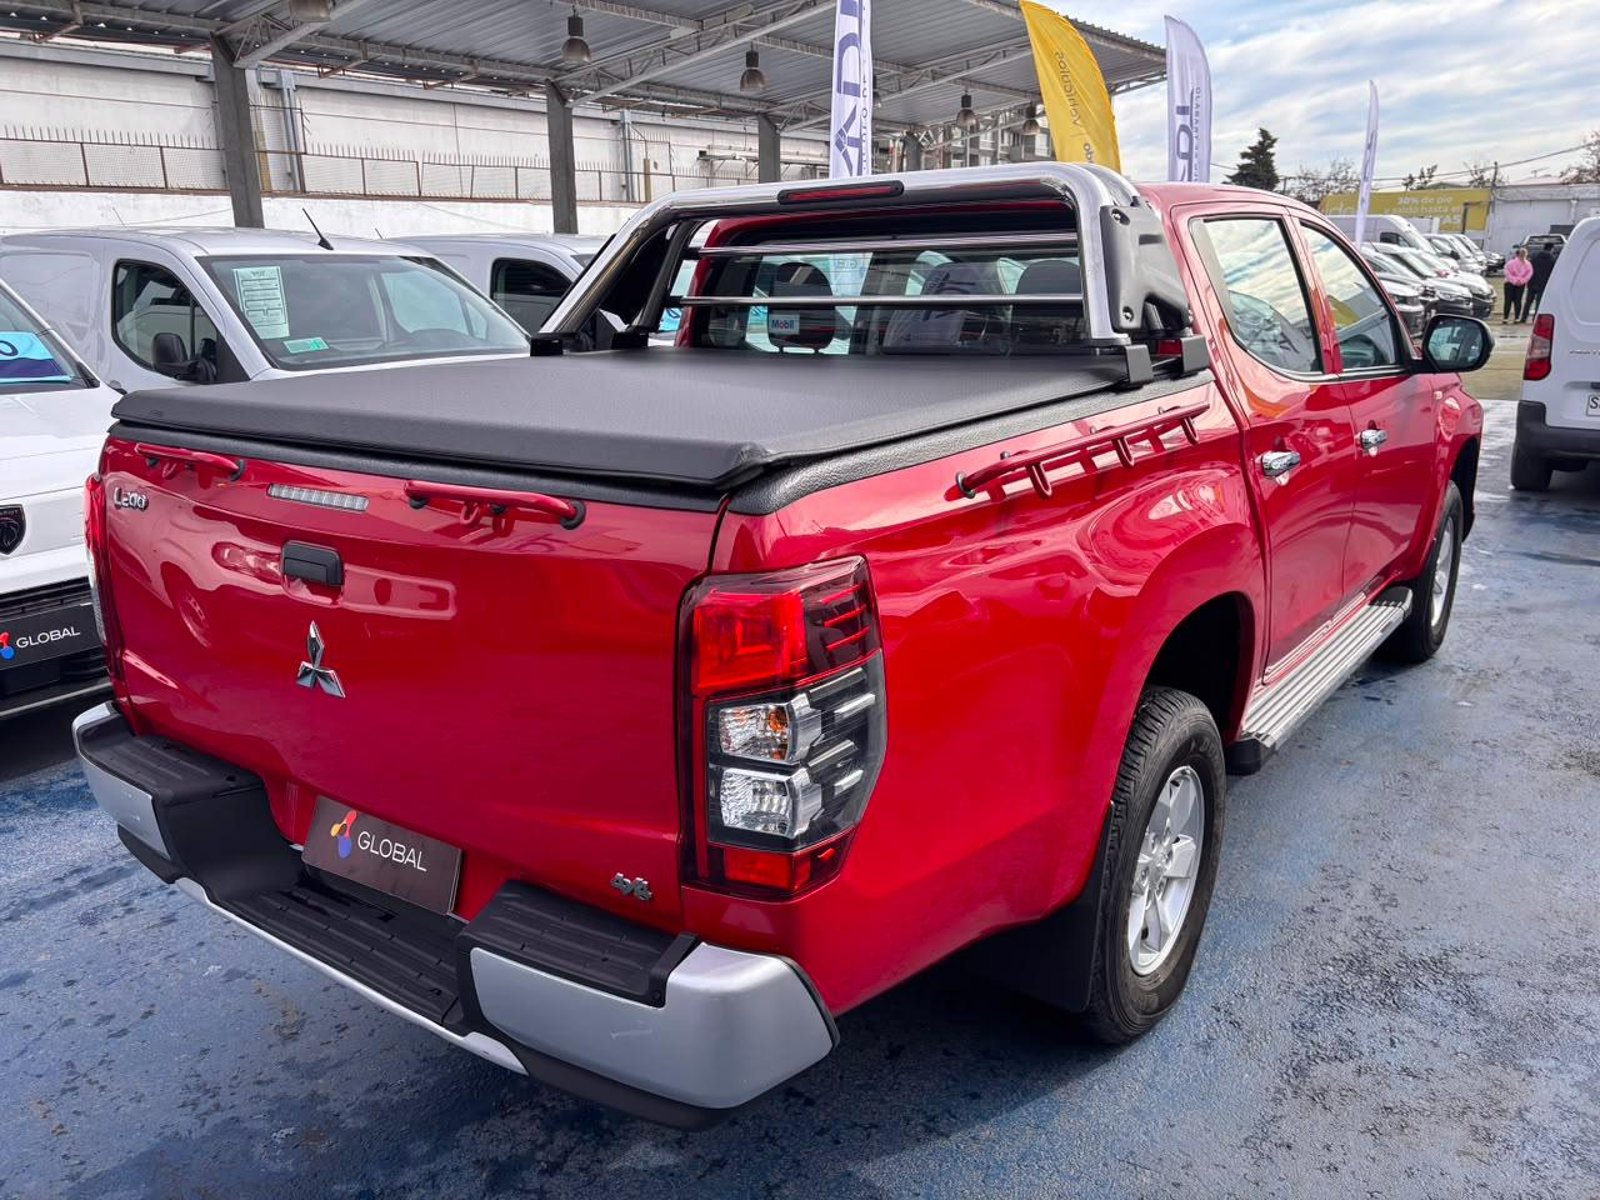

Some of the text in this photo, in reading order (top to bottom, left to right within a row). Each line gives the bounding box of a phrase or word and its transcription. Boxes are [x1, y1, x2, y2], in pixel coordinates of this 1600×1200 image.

[771, 319, 795, 329] Mobil
[16, 626, 81, 648] GLOBAL
[357, 830, 428, 872] GLOBAL
